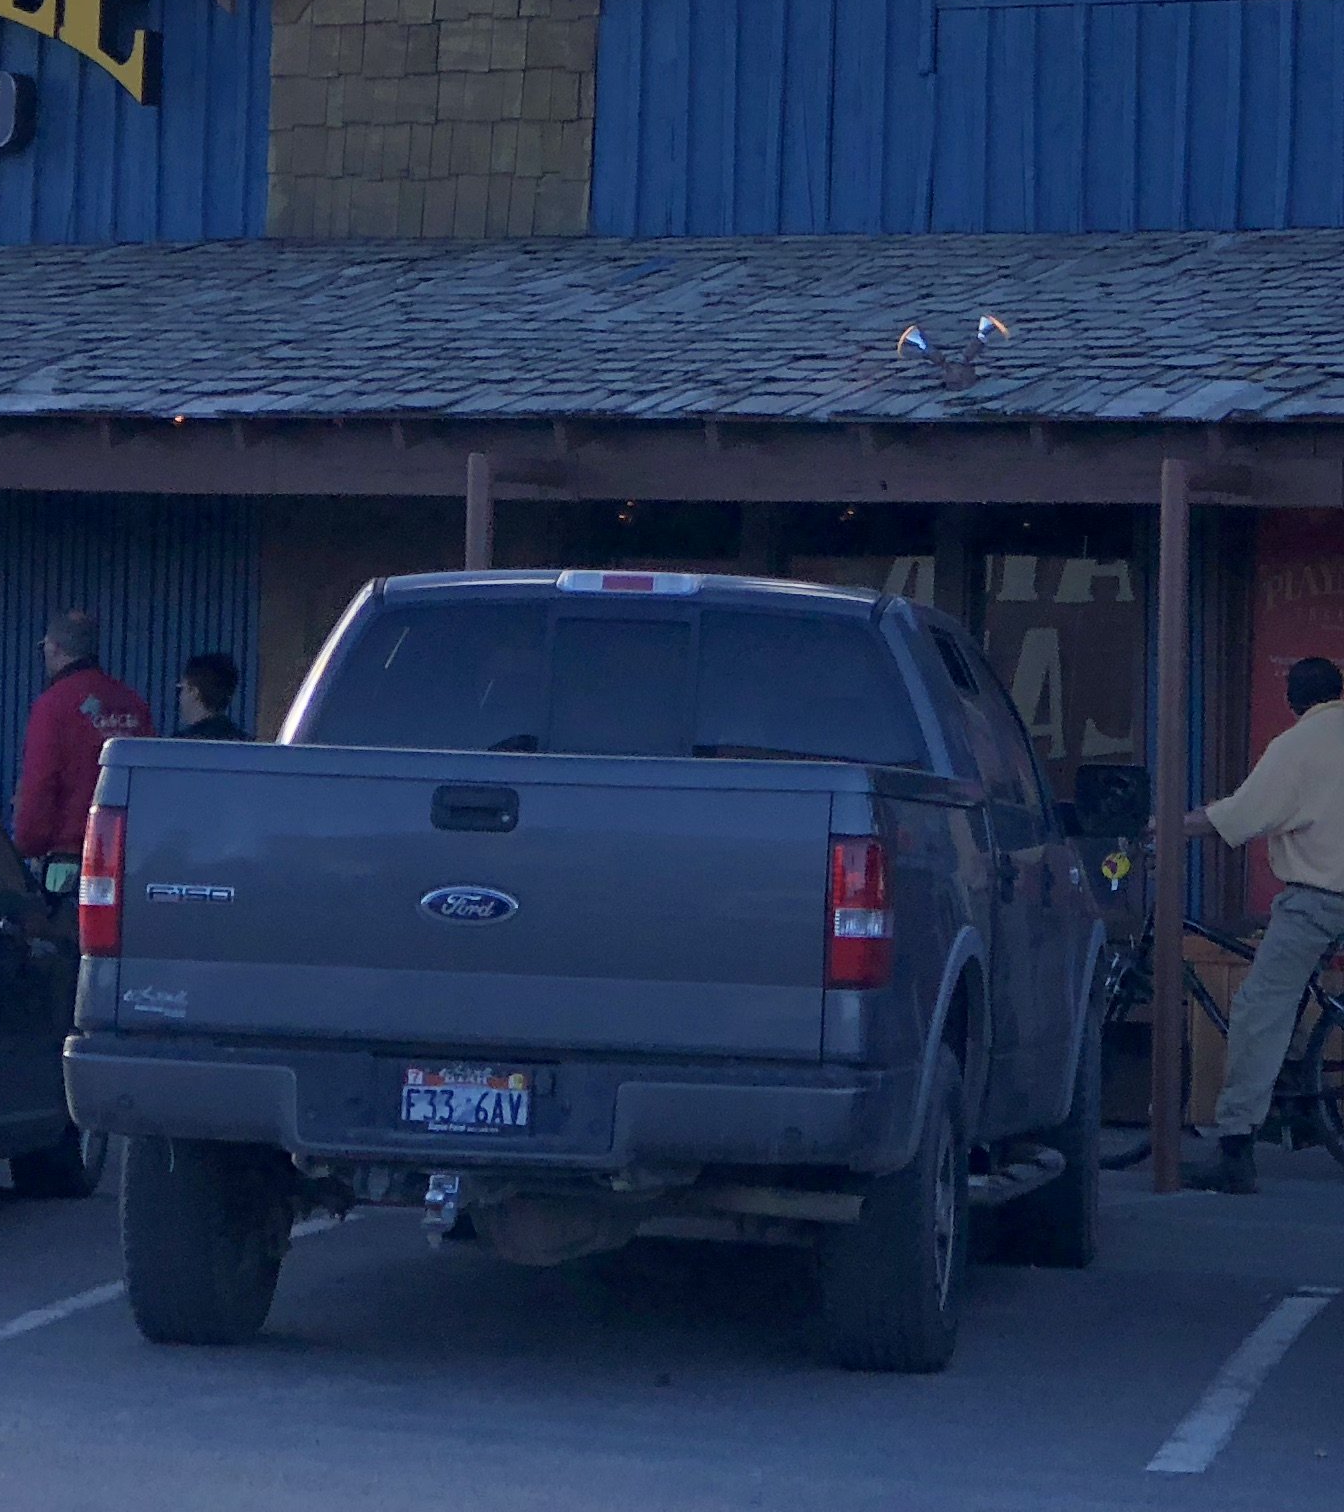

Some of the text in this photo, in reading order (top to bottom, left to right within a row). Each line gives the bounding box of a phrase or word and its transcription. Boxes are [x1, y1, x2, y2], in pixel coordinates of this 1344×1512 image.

[441, 894, 496, 917] Ford
[406, 1088, 522, 1126] F33 6AV
